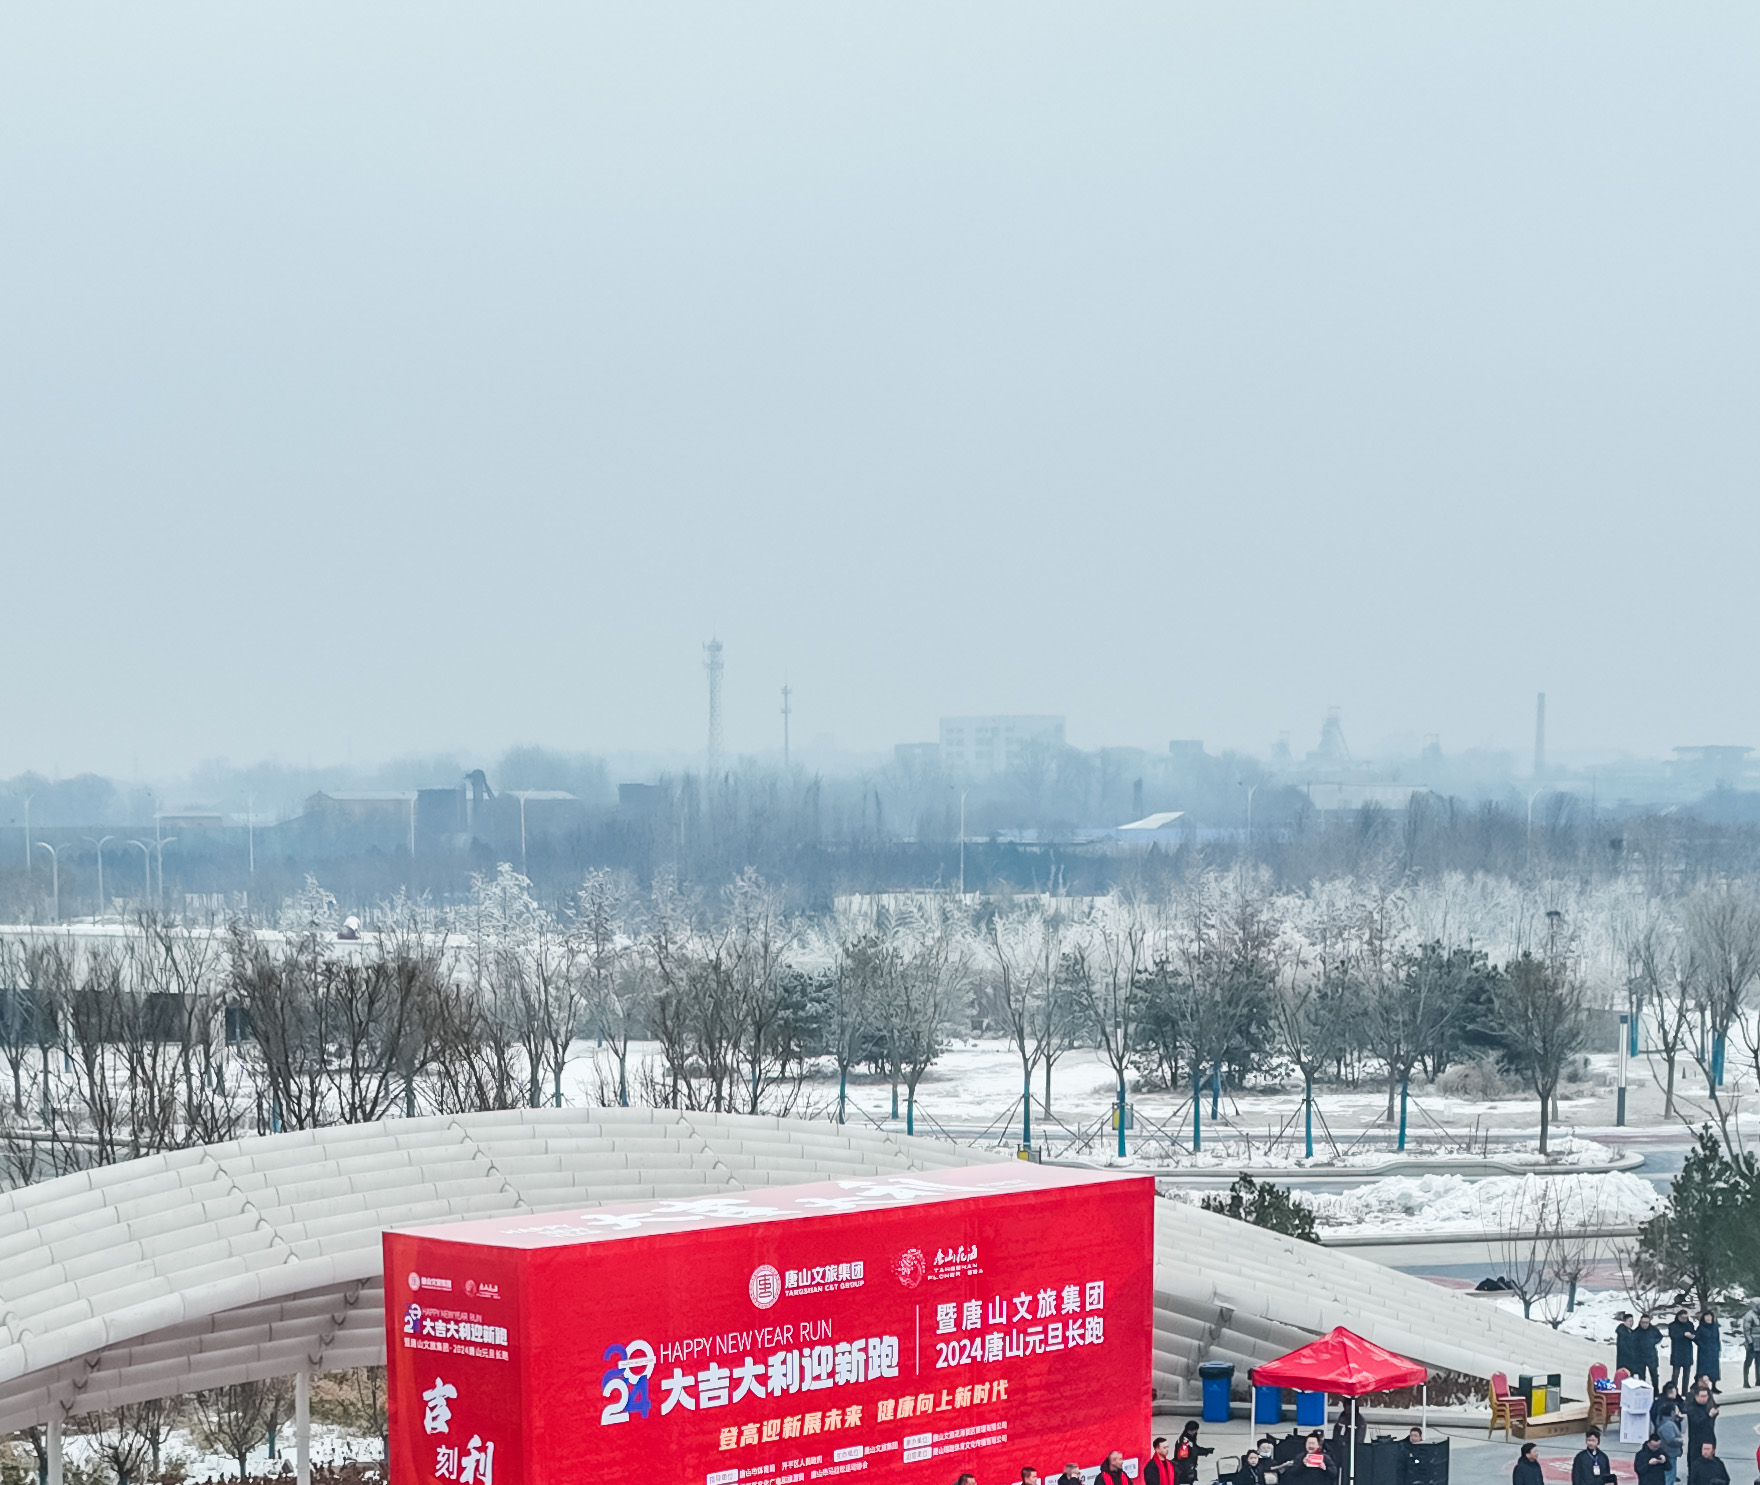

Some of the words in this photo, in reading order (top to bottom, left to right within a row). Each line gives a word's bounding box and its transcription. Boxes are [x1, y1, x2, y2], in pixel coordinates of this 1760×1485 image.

[784, 1260, 864, 1289] 唐山文旅集团
[422, 1318, 508, 1346] 大吉大利迎新跑
[936, 1280, 1105, 1335] 暨唐山文旅集团
[660, 1336, 713, 1364] HAPPY
[716, 1330, 753, 1355] NEW
[756, 1325, 794, 1349] YEAR
[800, 1318, 832, 1342] RUN
[935, 1315, 1105, 1369] 2024唐山元旦长跑
[660, 1334, 899, 1416] 大吉大利迎新跑
[718, 1404, 863, 1451] 登高迎新展未来
[876, 1379, 1009, 1423] 健康向上新时代
